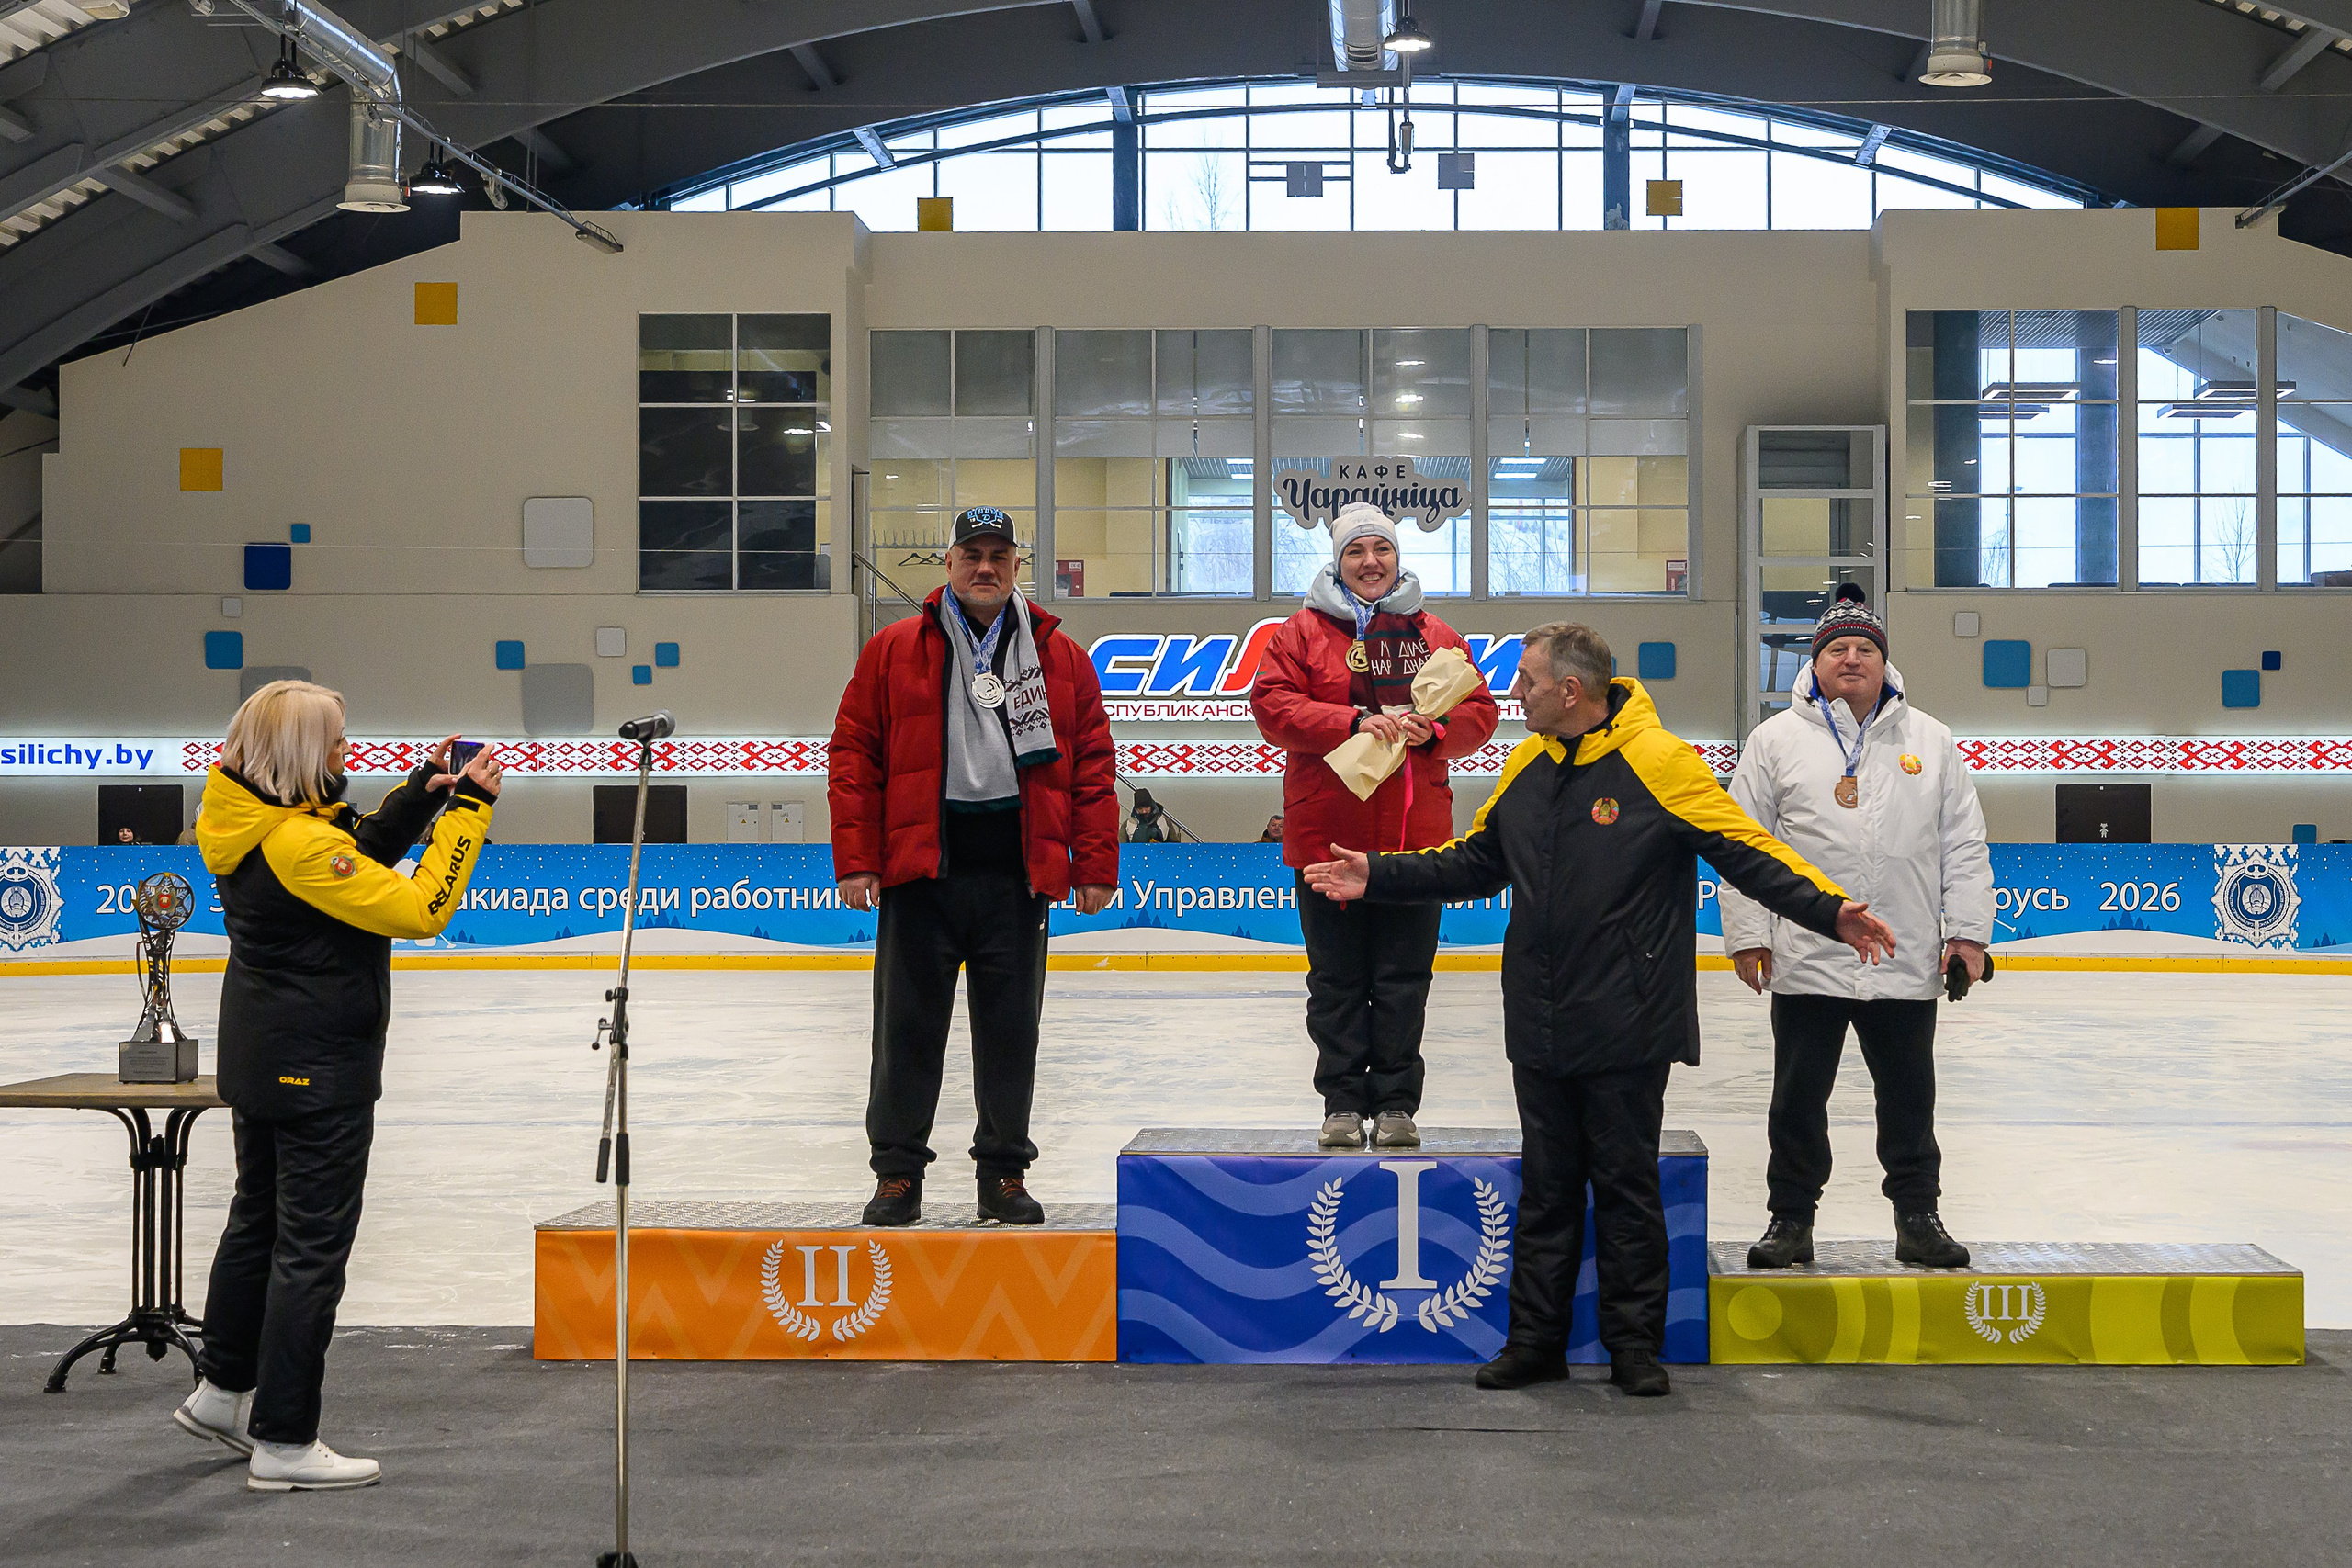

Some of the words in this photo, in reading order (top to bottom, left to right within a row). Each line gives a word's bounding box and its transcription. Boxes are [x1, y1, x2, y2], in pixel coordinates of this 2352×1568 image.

[1340, 465, 1406, 479] КАФЕ
[1283, 478, 1463, 524] Чараўніца
[1, 743, 153, 770] silichy.by
[427, 835, 471, 916] BELARUS
[578, 887, 680, 918] среди
[2098, 881, 2181, 911] 2026
[278, 1076, 311, 1086] ORAZ
[1379, 1161, 1438, 1289] I
[795, 1245, 857, 1306] II
[1977, 1284, 2033, 1321] III
